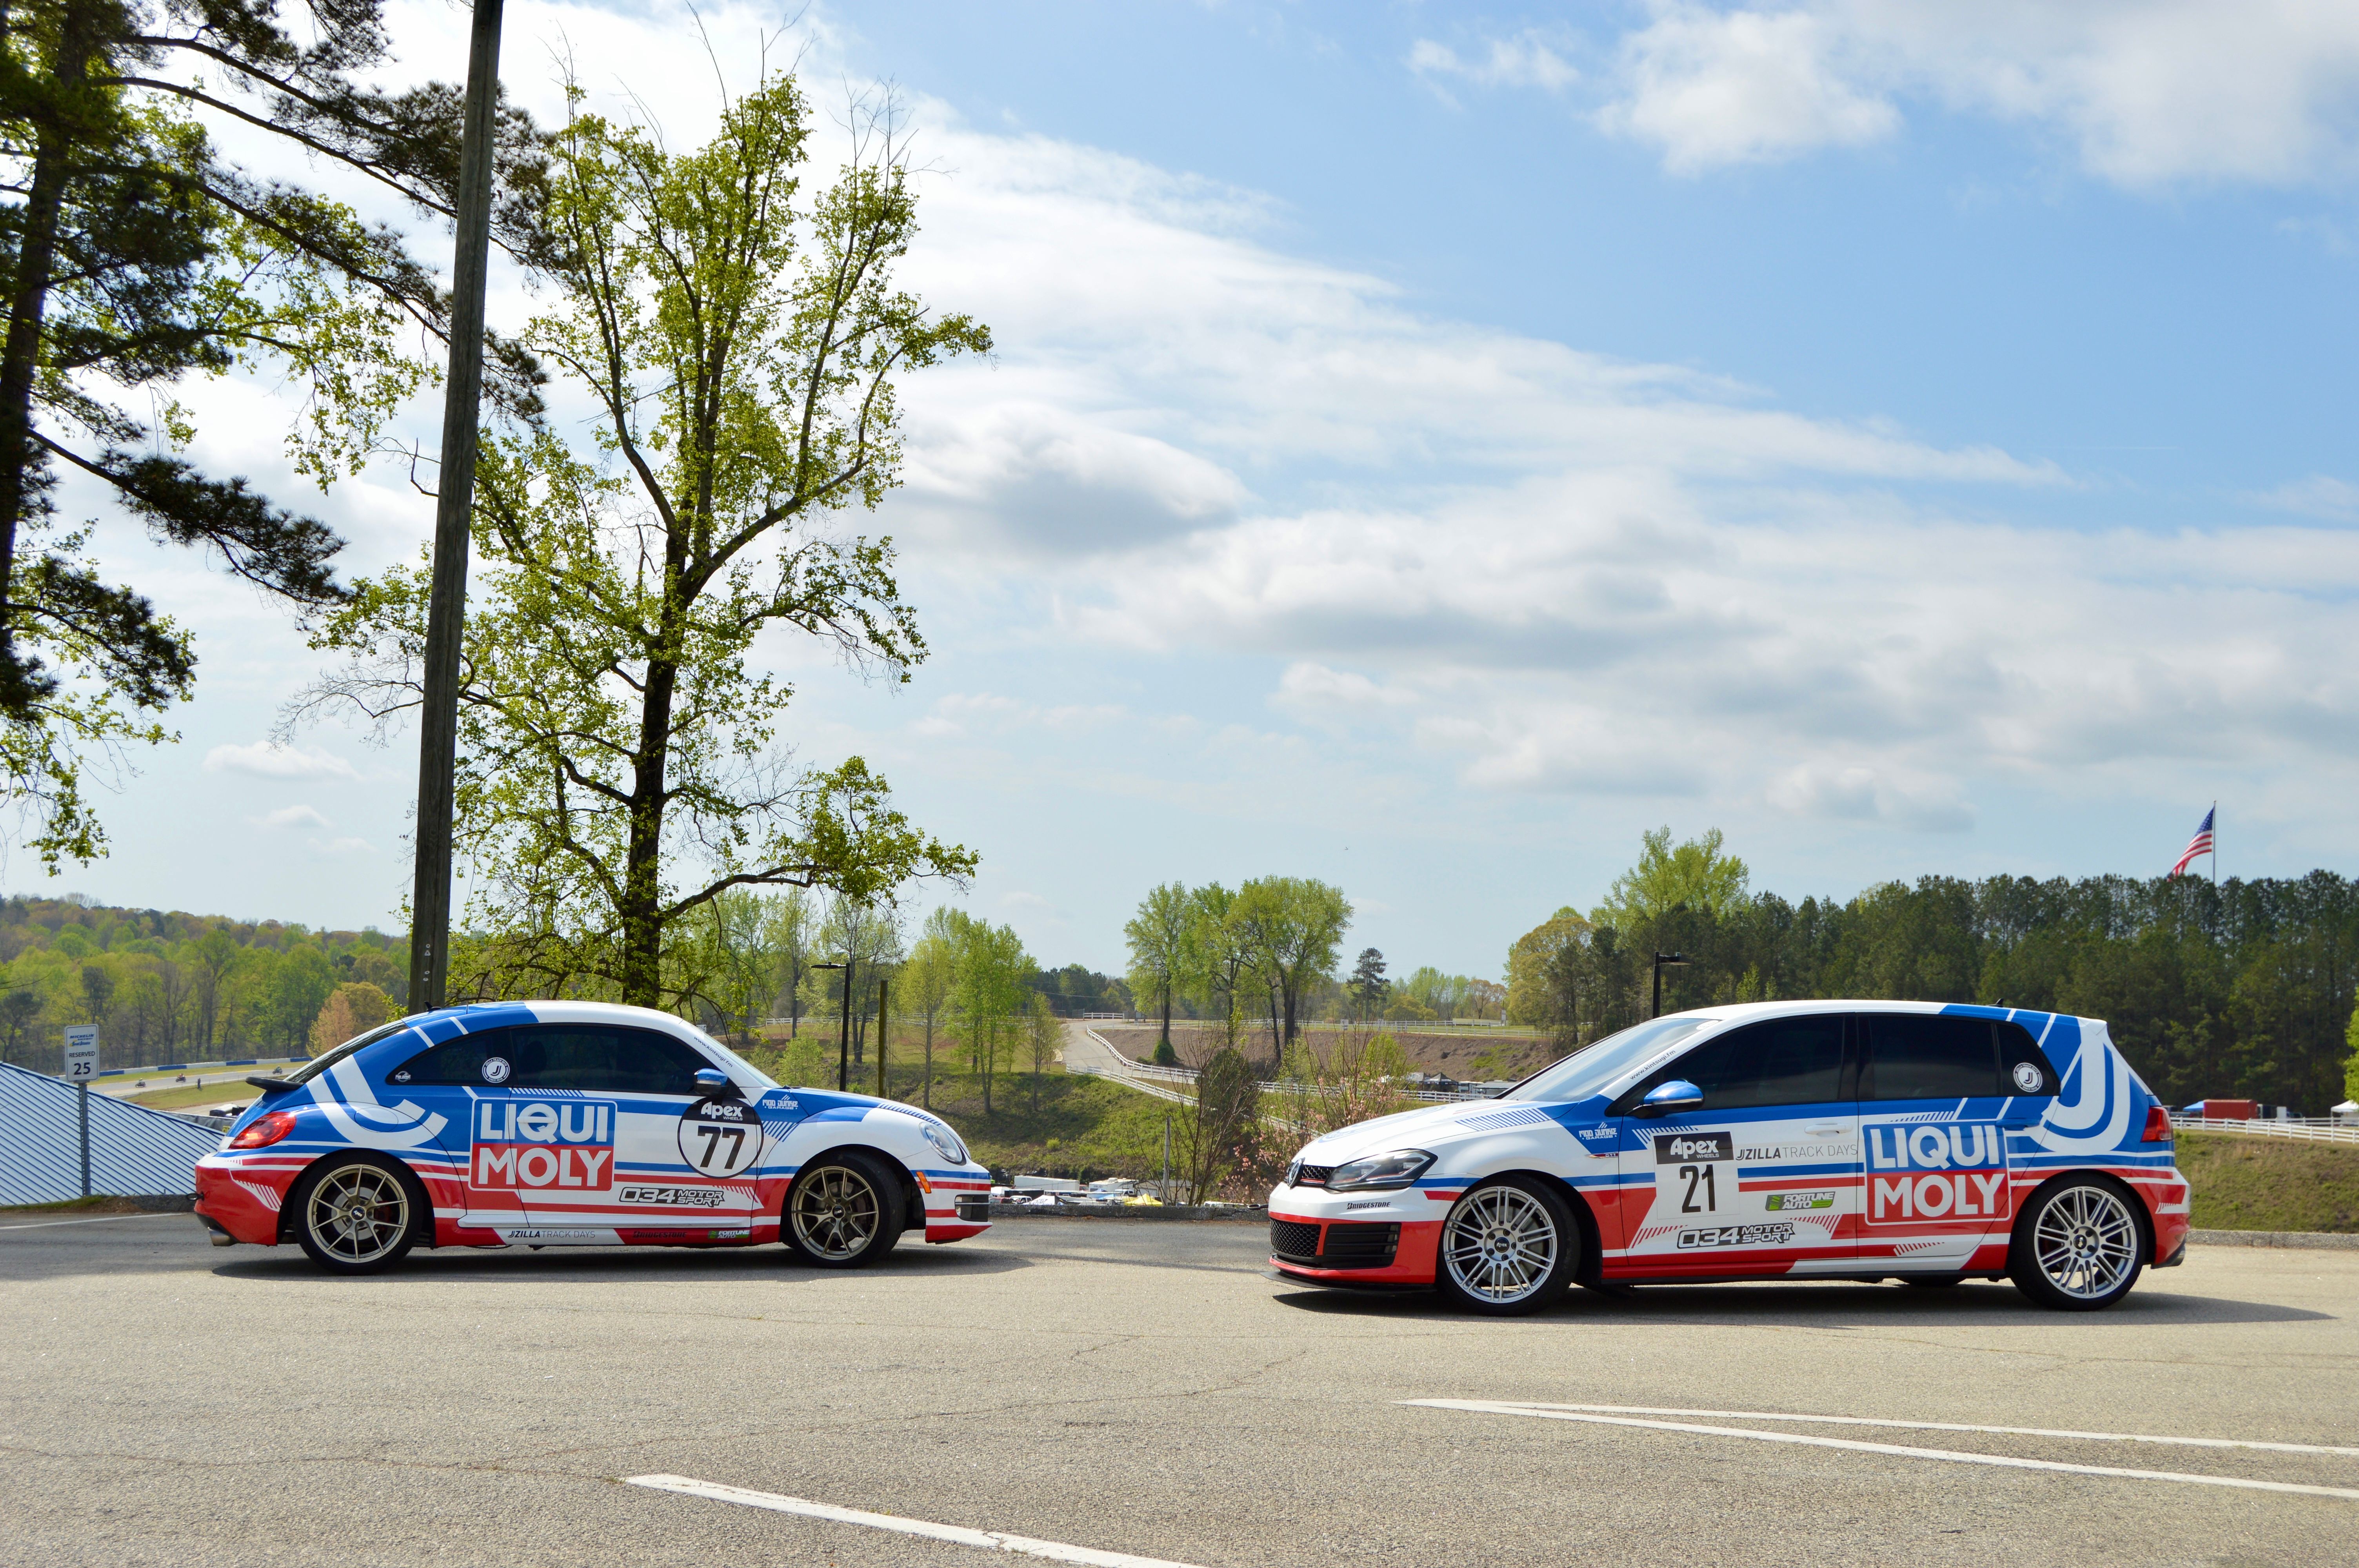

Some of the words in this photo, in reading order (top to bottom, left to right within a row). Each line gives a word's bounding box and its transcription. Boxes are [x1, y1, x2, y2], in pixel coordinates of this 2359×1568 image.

[74, 1062, 91, 1075] 25
[1630, 1050, 1676, 1080] www.kintsugi.fm
[701, 1101, 743, 1119] Apex
[480, 1103, 608, 1143] LIQUI
[698, 1125, 746, 1169] 77
[1670, 1137, 1719, 1159] Apex
[1782, 1146, 1824, 1157] TRACK
[1828, 1144, 1858, 1156] DAYS
[1870, 1125, 1999, 1170] LIQUI
[478, 1147, 611, 1186] MOLY
[620, 1188, 676, 1203] 034
[678, 1190, 723, 1200] MOTOR
[1679, 1164, 1716, 1213] 21
[1784, 1192, 1834, 1202] FORTUNE
[1874, 1174, 2005, 1218] MOLY
[677, 1197, 720, 1207] SPORT
[1782, 1201, 1812, 1209] AUTO
[1678, 1227, 1740, 1248] 034
[1742, 1224, 1793, 1234] MOTOR
[1742, 1232, 1790, 1243] SPORT
